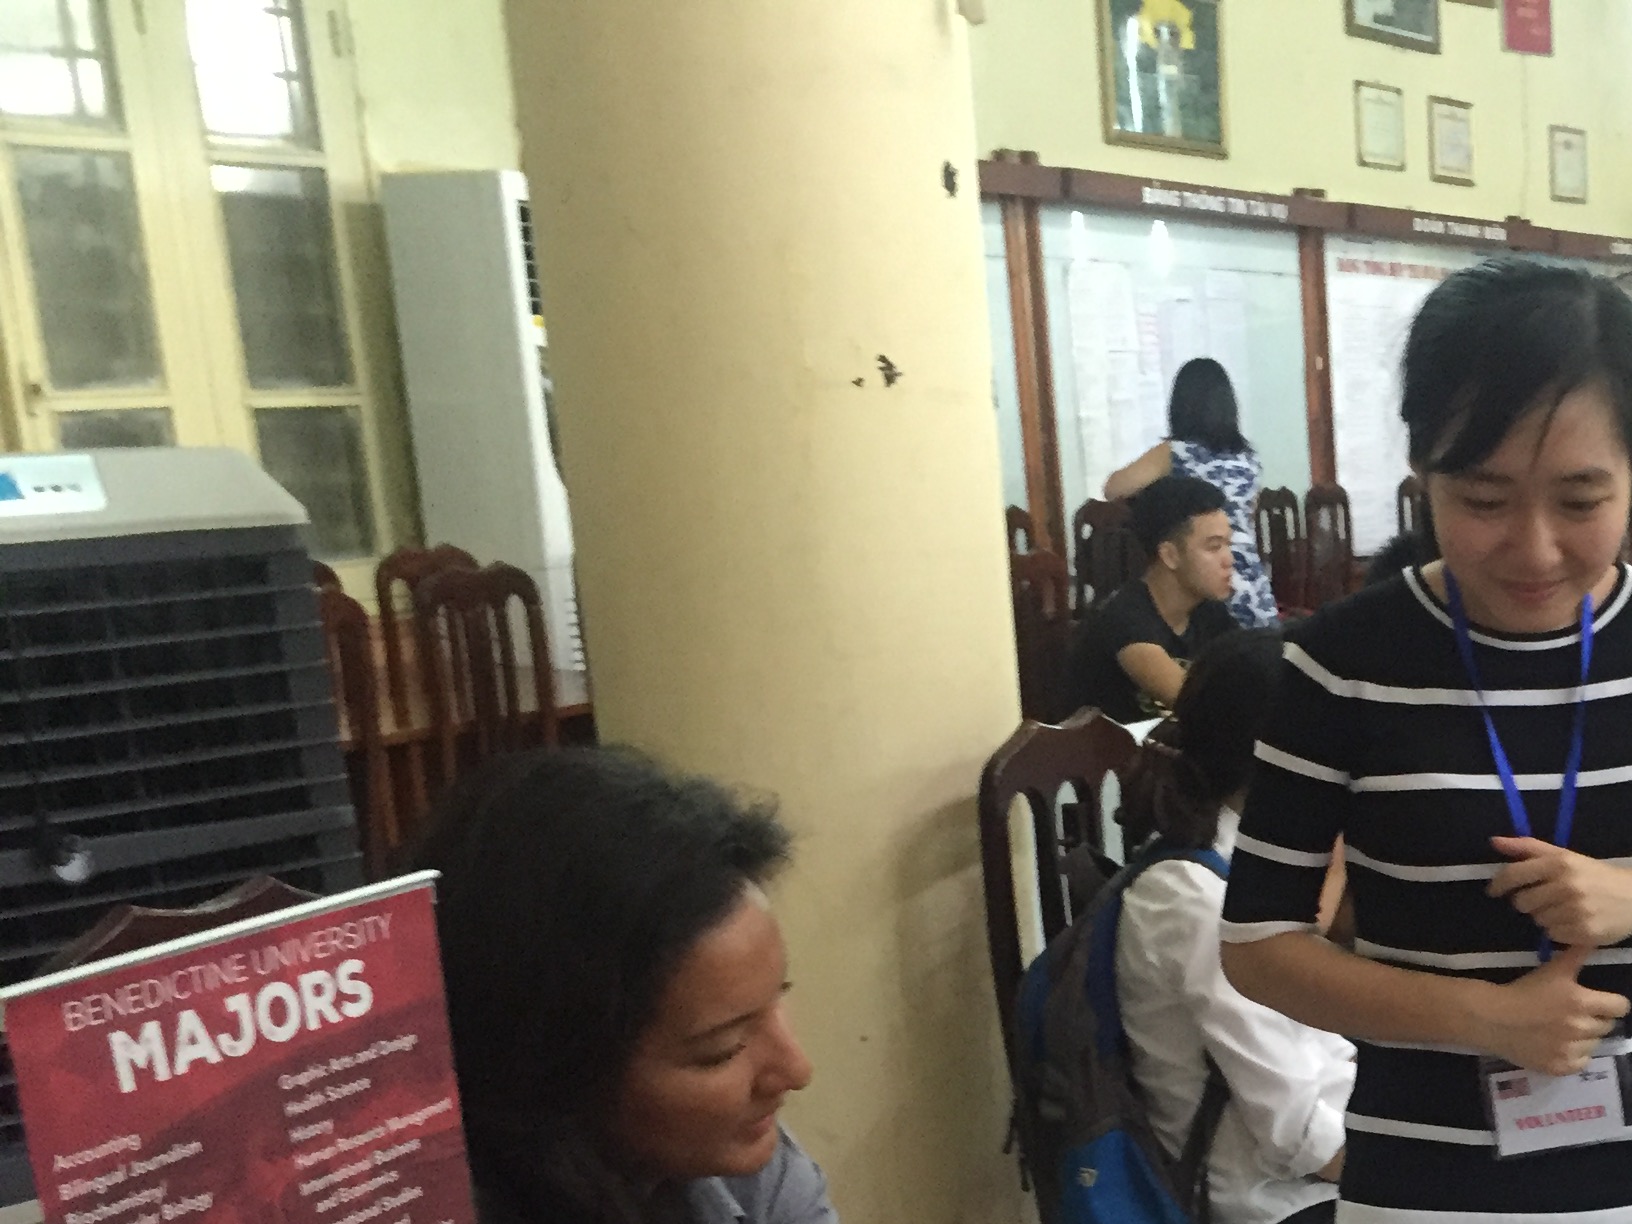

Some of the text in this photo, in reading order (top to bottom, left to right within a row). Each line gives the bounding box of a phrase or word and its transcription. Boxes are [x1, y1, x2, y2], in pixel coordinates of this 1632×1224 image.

[62, 911, 394, 1034] BENEDICTINE UNIVERSITY
[106, 957, 376, 1094] MAJORS
